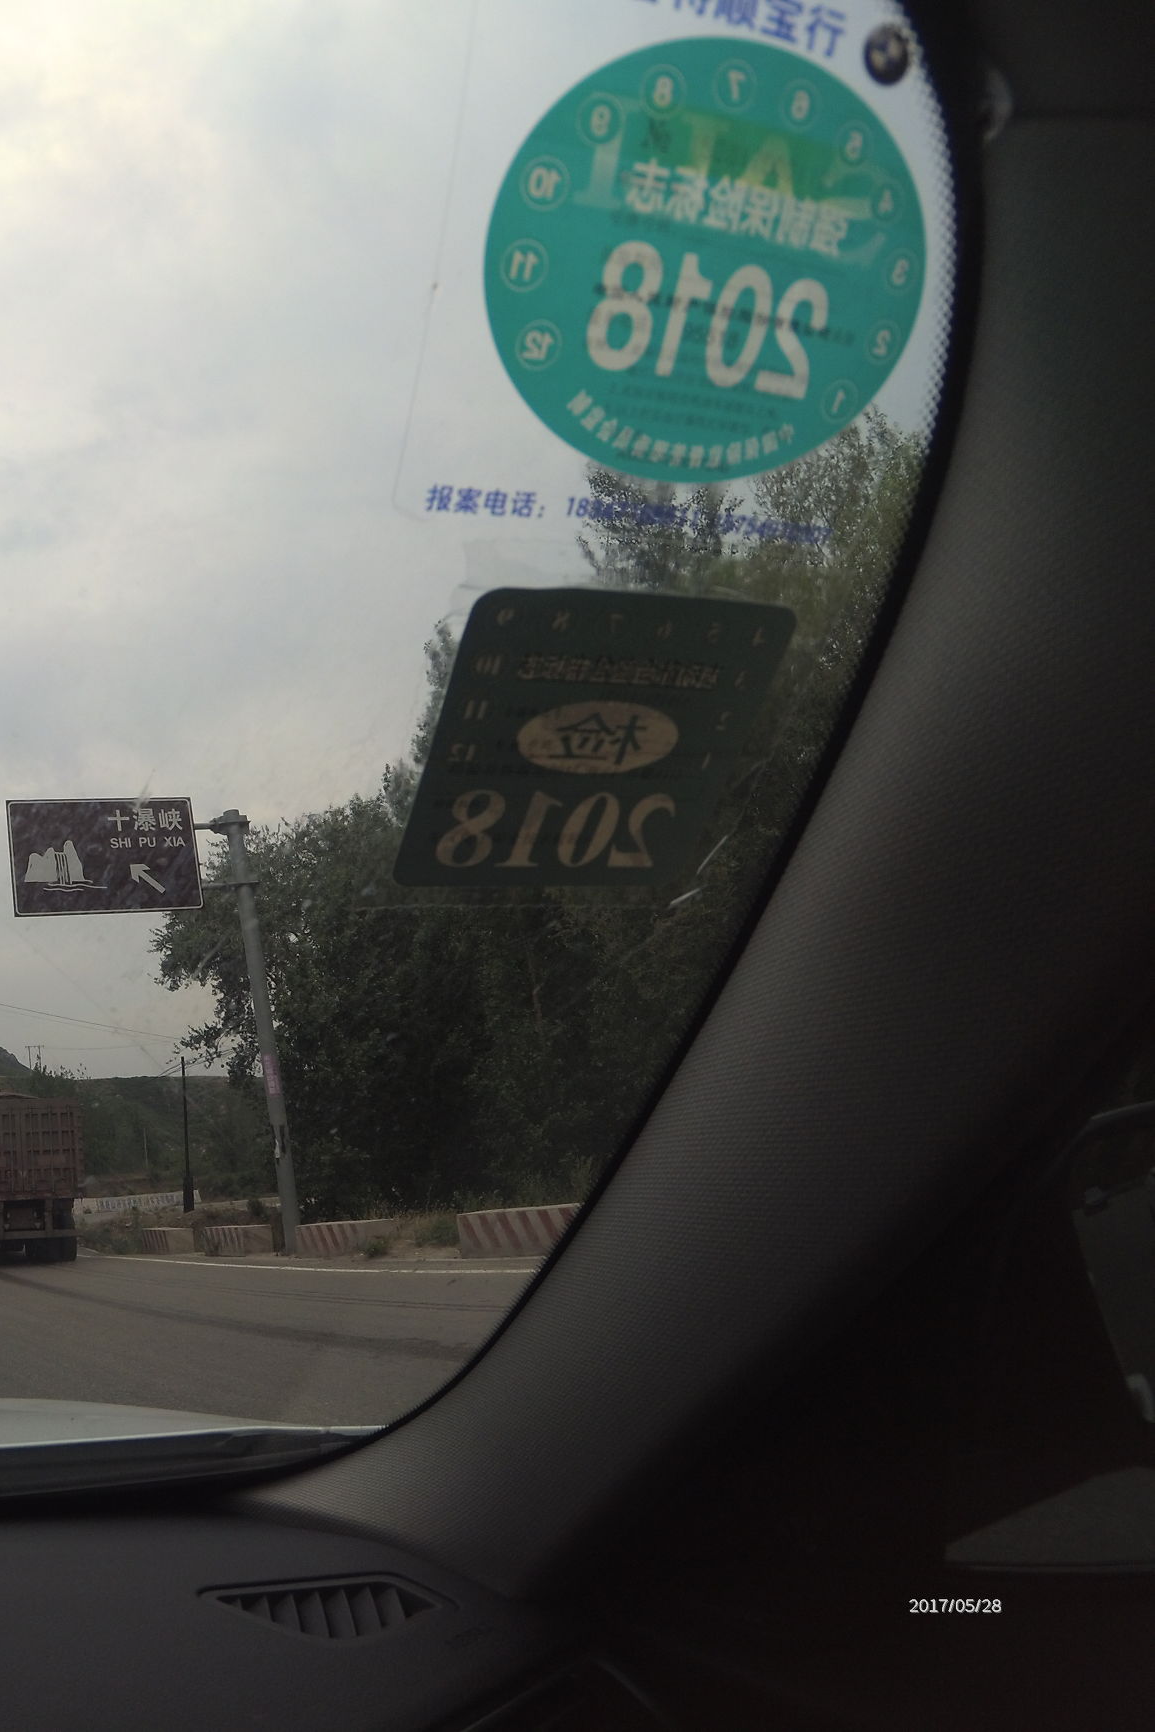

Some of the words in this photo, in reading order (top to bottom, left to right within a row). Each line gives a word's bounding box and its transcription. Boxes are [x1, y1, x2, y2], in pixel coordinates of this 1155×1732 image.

[107, 808, 183, 832] 十瀑峡
[110, 837, 132, 849] SHI
[139, 837, 157, 848] PU
[164, 836, 186, 848] XIA
